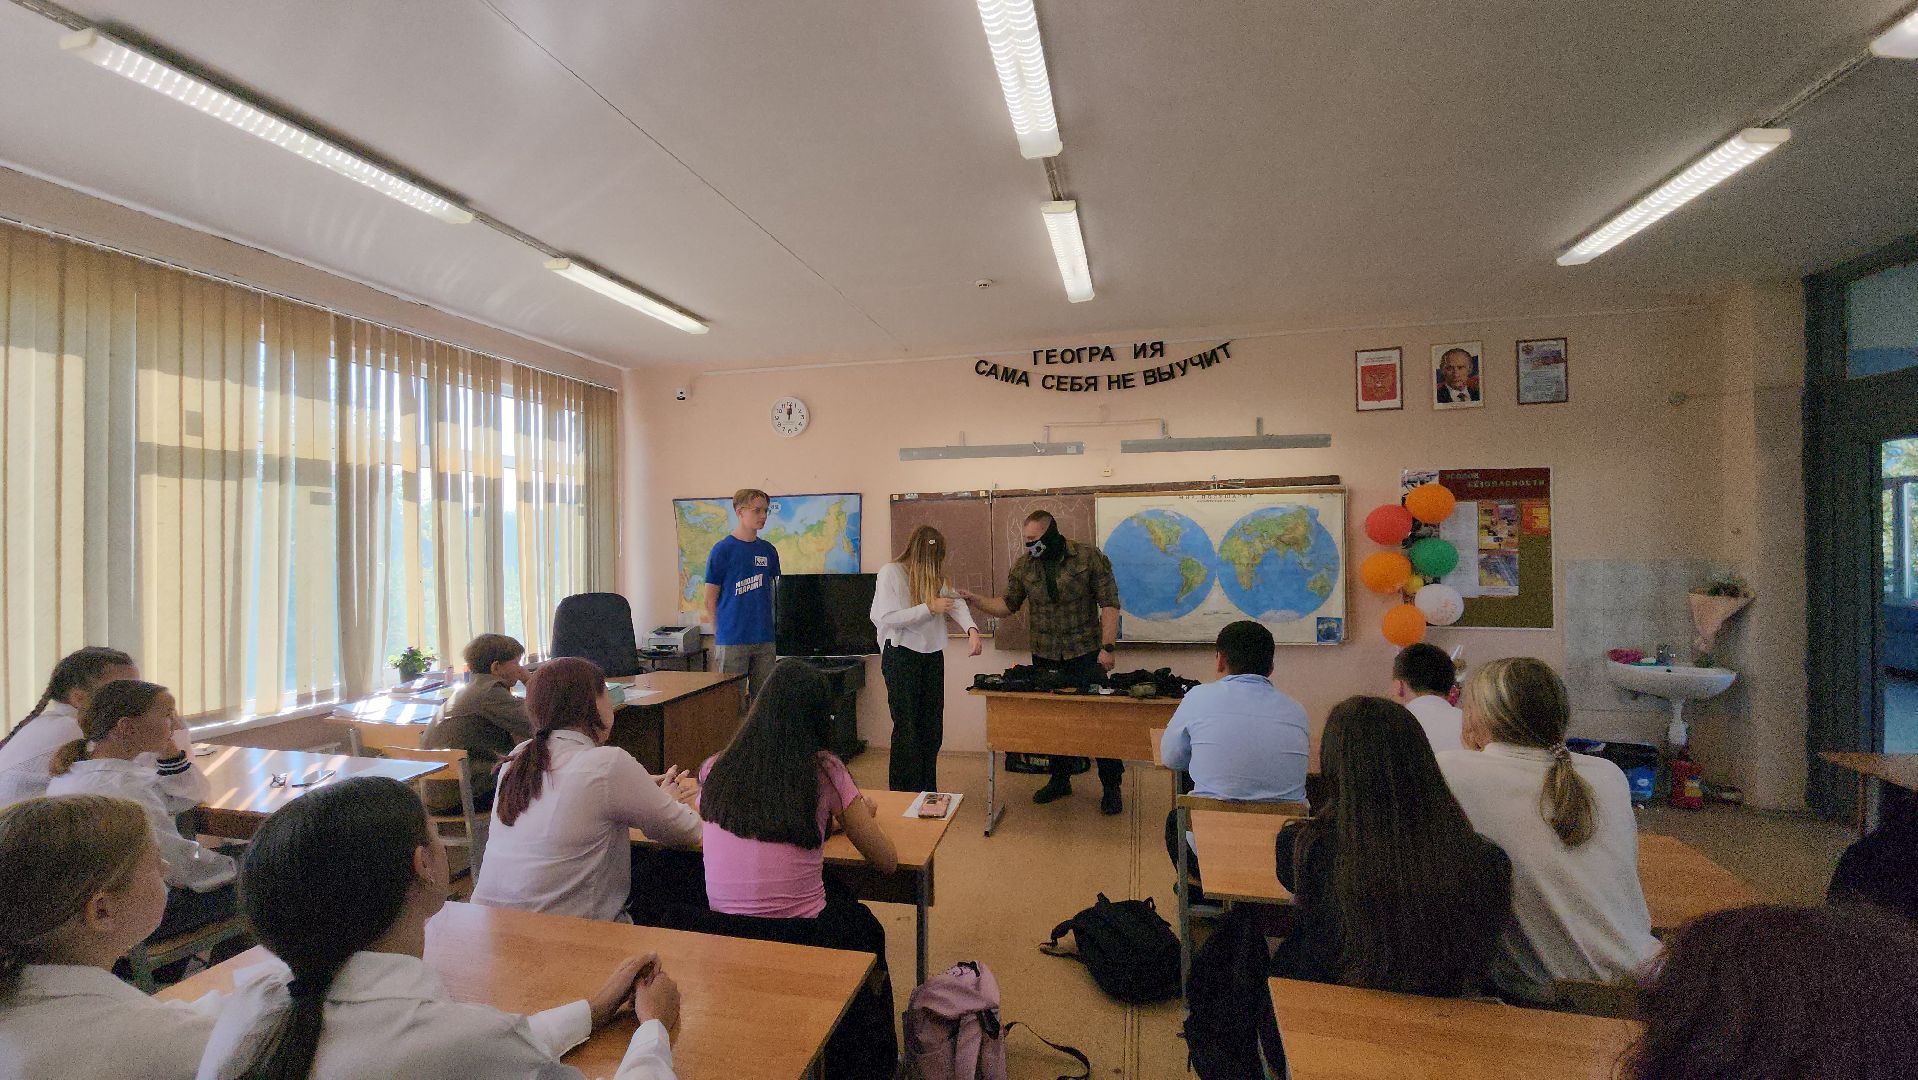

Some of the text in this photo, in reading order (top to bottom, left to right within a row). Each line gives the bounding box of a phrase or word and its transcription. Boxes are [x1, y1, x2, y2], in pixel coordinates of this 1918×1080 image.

[974, 341, 1232, 392] САМА СЕБЯ НЕ ВЫУЧИТ
[1032, 341, 1164, 366] ГЕОГРА ИЯ
